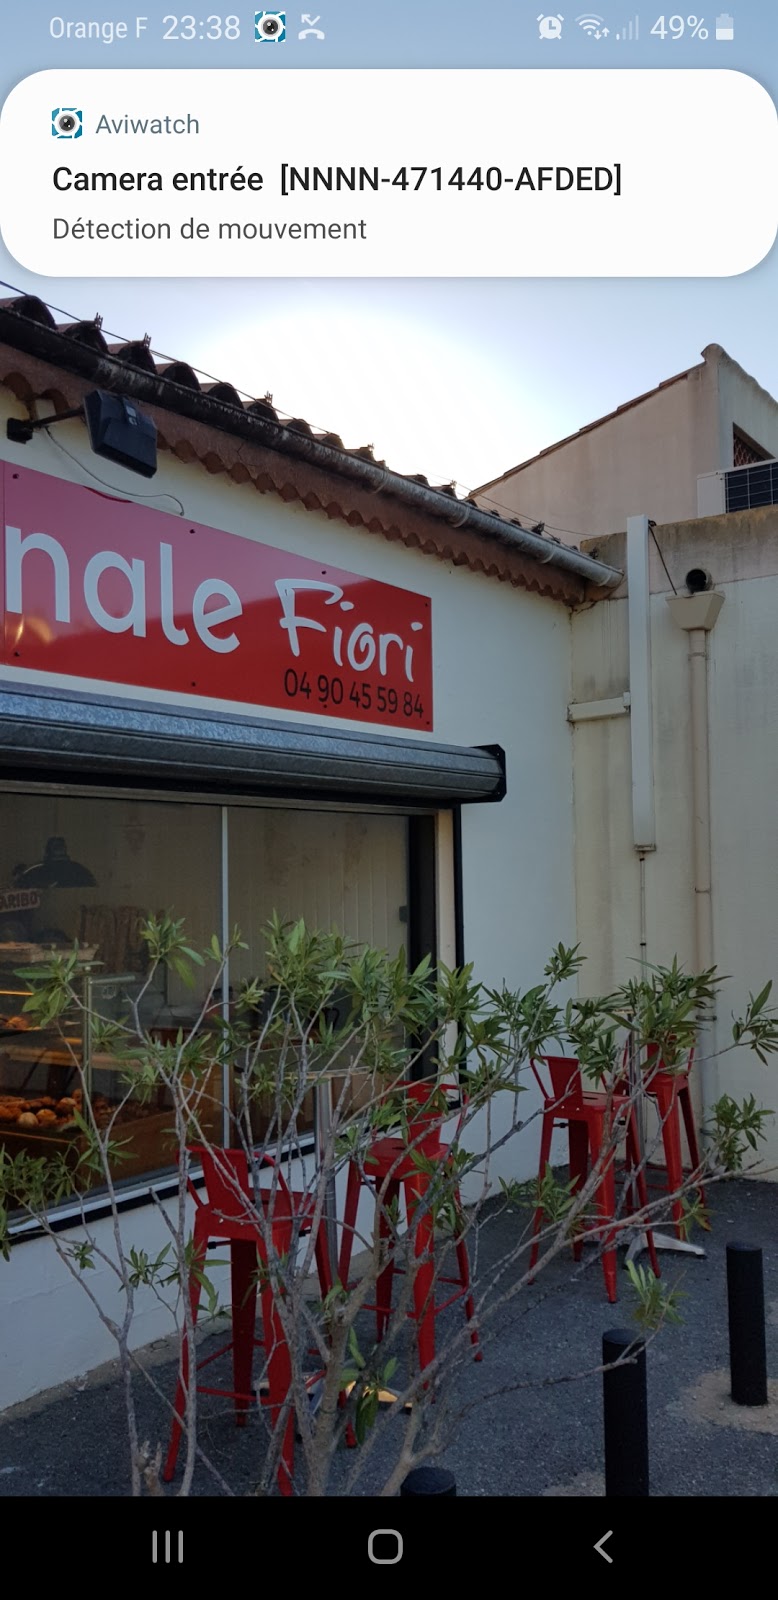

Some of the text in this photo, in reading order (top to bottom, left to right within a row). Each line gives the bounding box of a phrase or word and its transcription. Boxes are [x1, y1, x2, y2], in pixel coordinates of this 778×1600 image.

[5, 525, 423, 682] nale Fiori
[284, 668, 424, 719] 04 90 45 59 84
